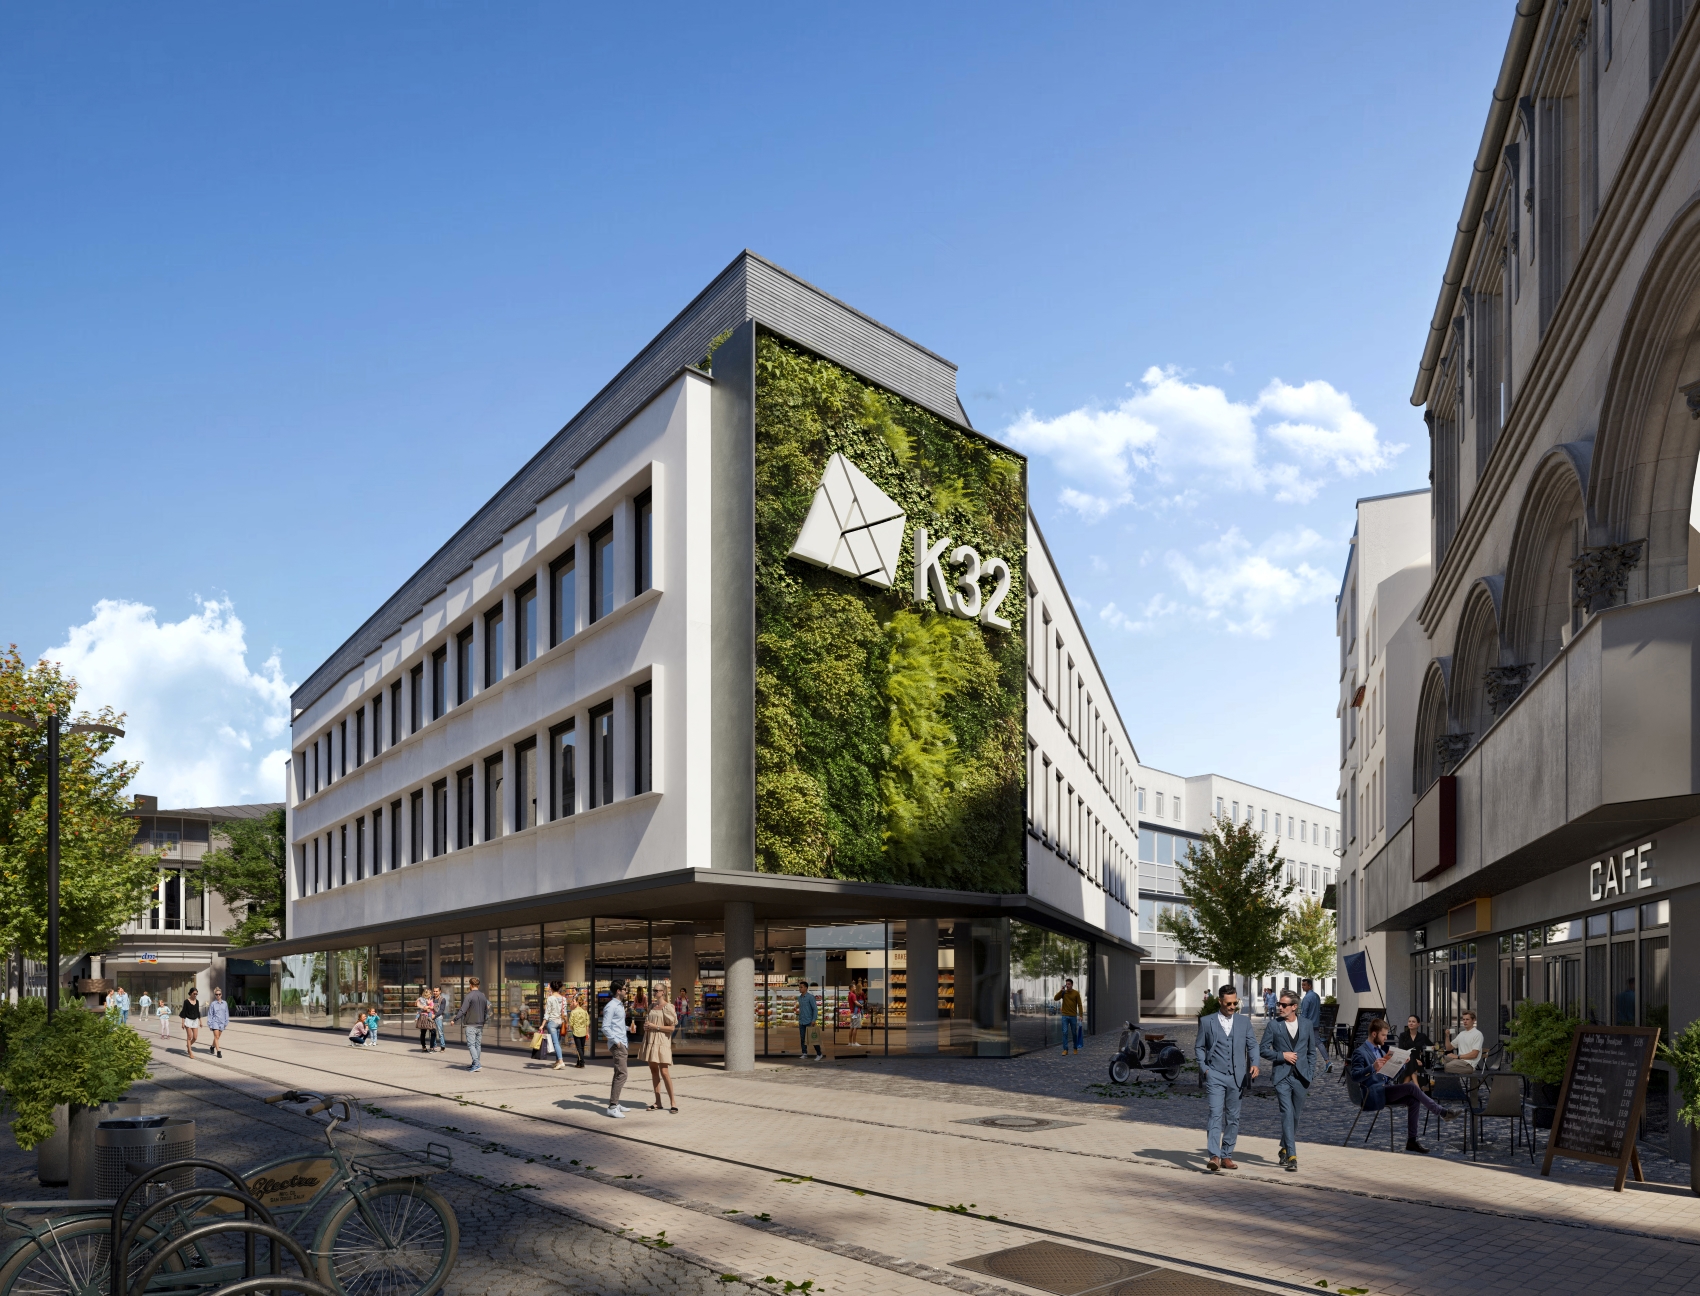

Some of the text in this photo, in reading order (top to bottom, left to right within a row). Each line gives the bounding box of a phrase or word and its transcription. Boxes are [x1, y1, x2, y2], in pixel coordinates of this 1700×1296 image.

[914, 528, 1011, 631] K32
[1590, 842, 1653, 901] CAFE
[141, 952, 156, 960] dm
[250, 1175, 320, 1200] Electra
